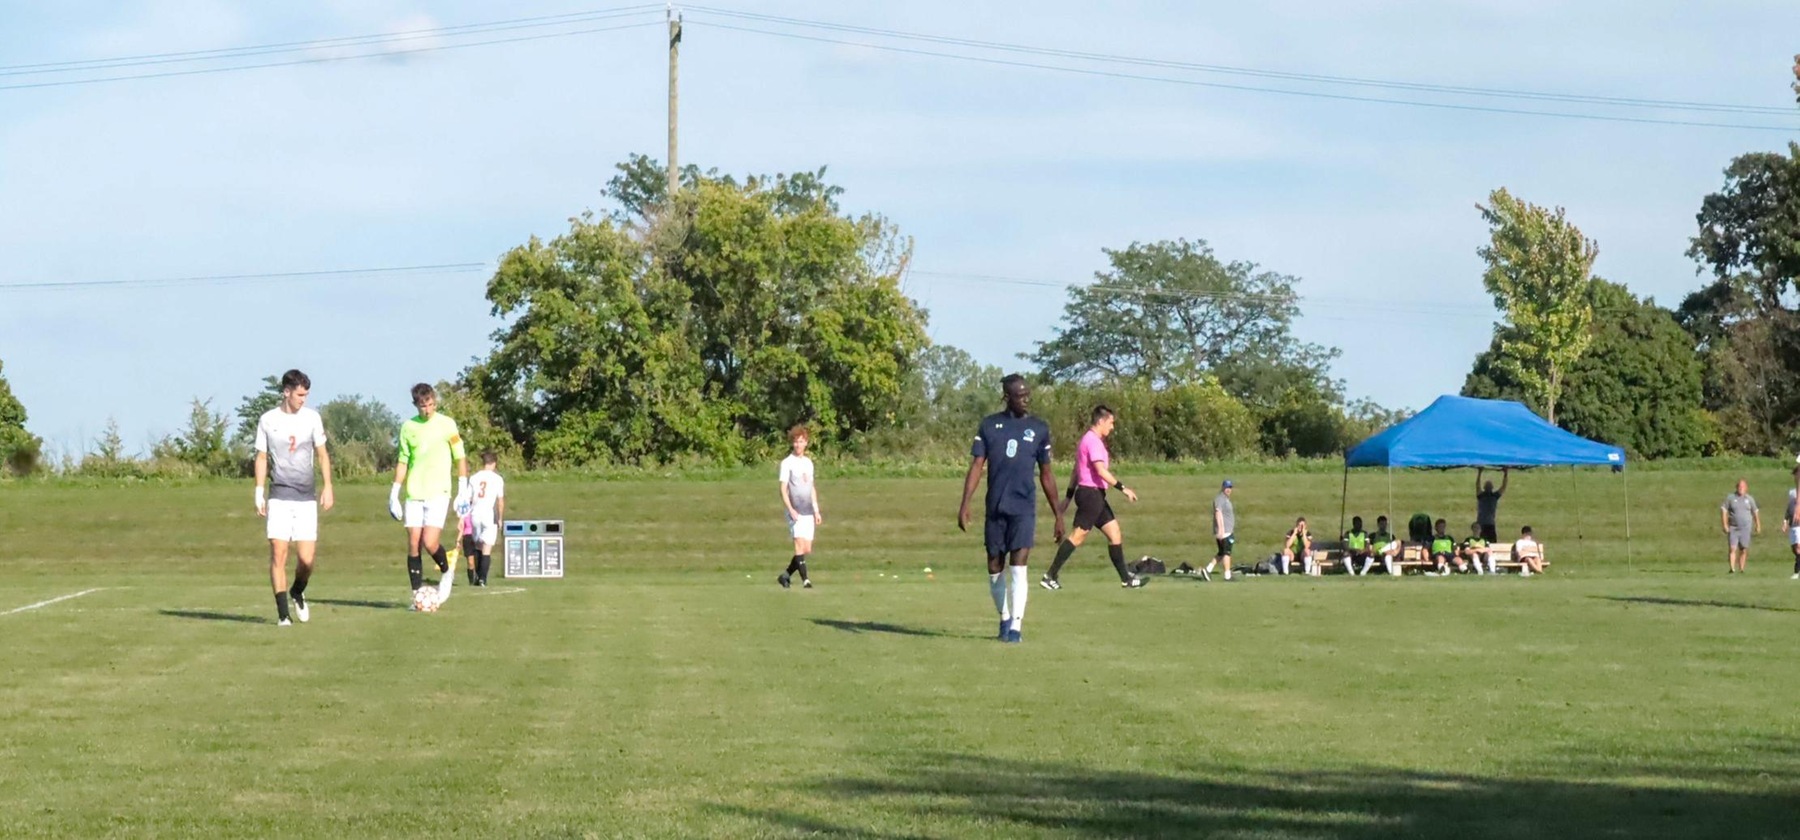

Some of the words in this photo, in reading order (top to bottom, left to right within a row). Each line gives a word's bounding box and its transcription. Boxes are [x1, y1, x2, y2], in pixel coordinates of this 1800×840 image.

[289, 435, 297, 453] 2
[1006, 439, 1018, 457] 8
[478, 481, 487, 498] 3
